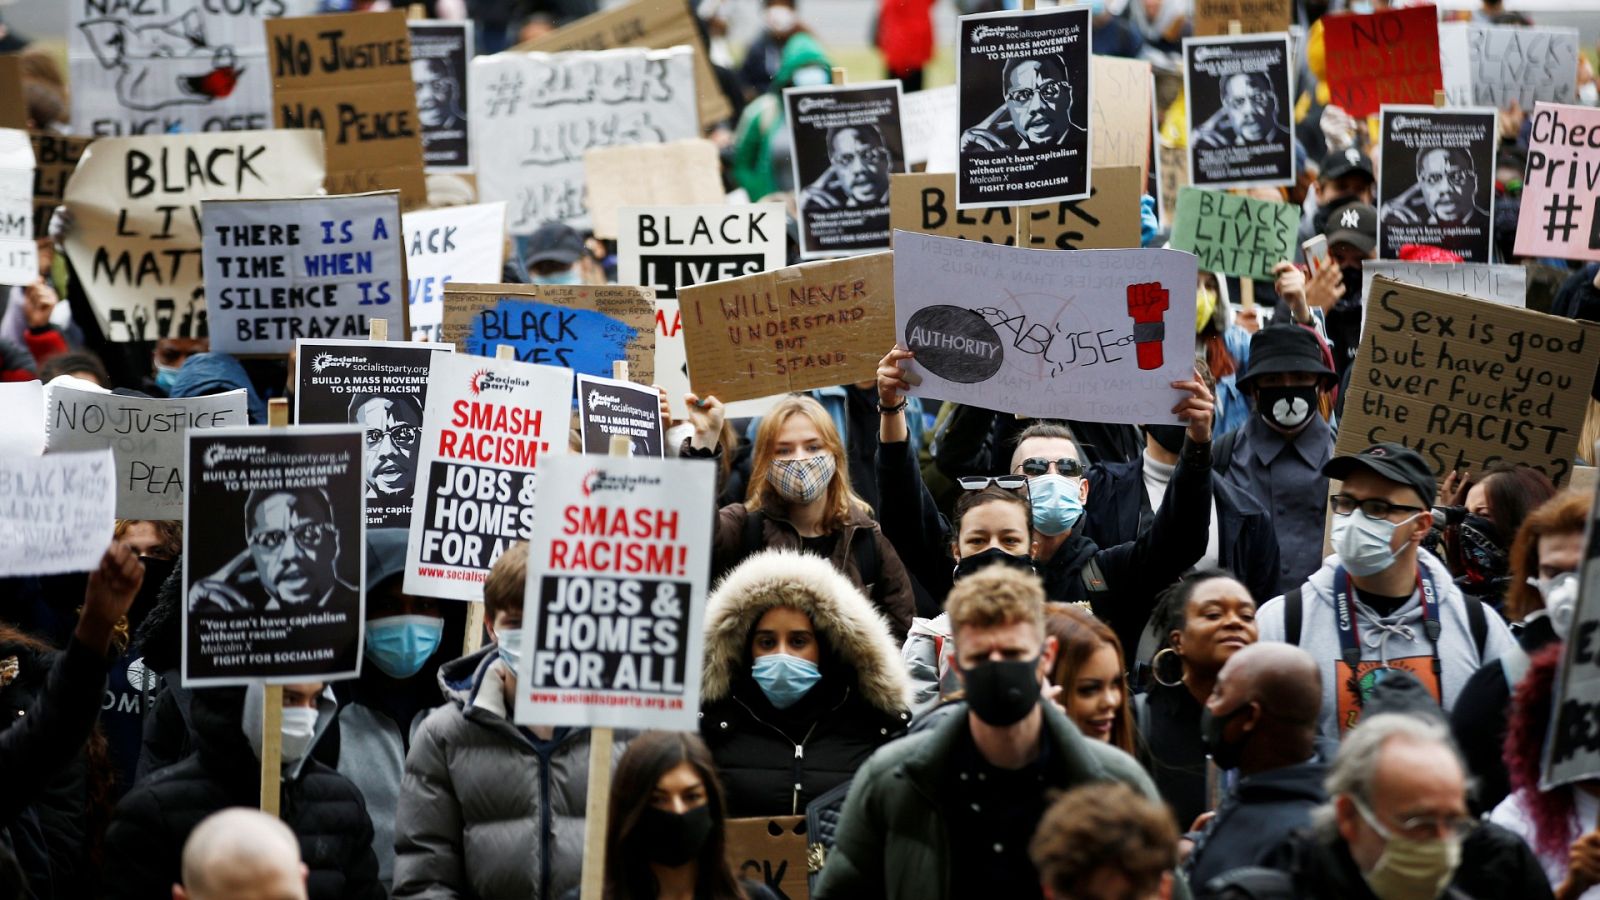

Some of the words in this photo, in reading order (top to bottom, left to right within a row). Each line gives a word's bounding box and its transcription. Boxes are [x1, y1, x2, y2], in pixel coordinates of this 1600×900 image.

[984, 25, 1019, 33] Socialist
[1006, 25, 1080, 39] socialistparty.org.uk
[1351, 15, 1404, 49] NO
[274, 33, 312, 77] NO
[318, 30, 410, 73] JUSTICE
[971, 45, 996, 54] BUILD
[1006, 41, 1030, 50] MASS
[1032, 35, 1078, 48] MOVEMENT
[987, 53, 999, 61] TO
[1000, 50, 1030, 59] SMASH
[1032, 45, 1064, 56] RACISM
[1468, 28, 1566, 66] BLACK
[281, 103, 325, 129] NO
[335, 103, 415, 145] PEACE
[126, 145, 266, 198] BLACK
[969, 166, 1005, 176] without
[991, 155, 1013, 165] can't
[1014, 154, 1035, 163] have
[1036, 148, 1078, 162] capitalism
[969, 175, 1002, 185] Malcolm
[1003, 174, 1009, 182] X
[979, 184, 1004, 193] FIGHT
[1006, 182, 1023, 191] FOR
[1024, 176, 1069, 189] SOCIALISM
[1200, 190, 1289, 230] BLACK
[215, 224, 300, 247] THERE
[320, 220, 353, 244] IS
[372, 217, 389, 240] A
[410, 226, 457, 257] ACK
[638, 212, 769, 247] BLACK
[1195, 217, 1288, 253] LIVES
[216, 256, 285, 278] TIME
[304, 251, 373, 277] WHEN
[1193, 244, 1289, 276] MATTE
[219, 285, 338, 310] SILENCE
[357, 281, 391, 305] IS
[695, 301, 704, 325] I
[720, 291, 779, 320] WILL
[789, 279, 866, 307] NEVER
[236, 314, 371, 342] BETRAYAL
[480, 310, 579, 344] BLACK
[728, 306, 865, 345] UNDERSTAND
[1379, 290, 1456, 338] Sex
[1468, 314, 1494, 345] is
[1505, 329, 1586, 363] good
[775, 336, 807, 350] BUT
[909, 325, 1000, 359] AUTHORITY
[324, 354, 367, 363] Socialist
[352, 363, 430, 376] socialistparty.org.
[748, 363, 755, 379] I
[776, 352, 847, 375] STAND
[1371, 335, 1425, 369] but
[1437, 342, 1504, 381] have
[1512, 367, 1571, 393] you
[312, 376, 342, 385] BUILD
[353, 376, 381, 384] MASS
[383, 376, 429, 385] MOVEME
[383, 385, 420, 393] RACISM
[479, 381, 514, 393] Party
[485, 371, 530, 388] Socialist
[1369, 368, 1439, 396] ever
[1449, 374, 1555, 419] fucked
[56, 400, 105, 433] NO
[114, 407, 233, 434] JUSTICE
[451, 399, 542, 437] SMASH
[589, 414, 606, 423] BUILD
[607, 416, 612, 424] A
[613, 417, 629, 426] MASS
[600, 425, 608, 433] TO
[609, 426, 630, 435] SMASH
[1362, 390, 1408, 423] the
[1427, 404, 1568, 454] RACIST
[203, 470, 237, 482] BUILD
[239, 470, 247, 479] A
[249, 468, 282, 479] MASS
[284, 464, 348, 478] MOVEMENT
[250, 450, 350, 466] socialistparty.org.uk
[130, 460, 184, 494] PEA
[224, 481, 239, 491] TO
[242, 480, 283, 491] SMASH
[285, 476, 328, 489] RACISM
[436, 465, 512, 504] JOBS
[518, 474, 536, 506] &
[433, 497, 534, 540] HOMES
[563, 505, 678, 541] SMASH
[421, 530, 483, 567] FOR
[549, 540, 688, 576] RACISM!
[547, 578, 643, 616] JOBS
[650, 583, 682, 620] &
[1422, 578, 1435, 605] EOS
[229, 618, 257, 629] can't
[260, 616, 287, 628] have
[289, 612, 346, 628] capitalism
[1337, 592, 1351, 631] Canon
[200, 630, 246, 642] without
[200, 644, 242, 655] Malcolm
[245, 643, 252, 651] X
[545, 614, 679, 655] HOMES
[213, 654, 246, 666] FIGHT
[249, 653, 271, 663] FOR
[274, 648, 334, 663] SOCIALISM
[533, 653, 605, 688] FOR
[613, 654, 684, 692] ALL
